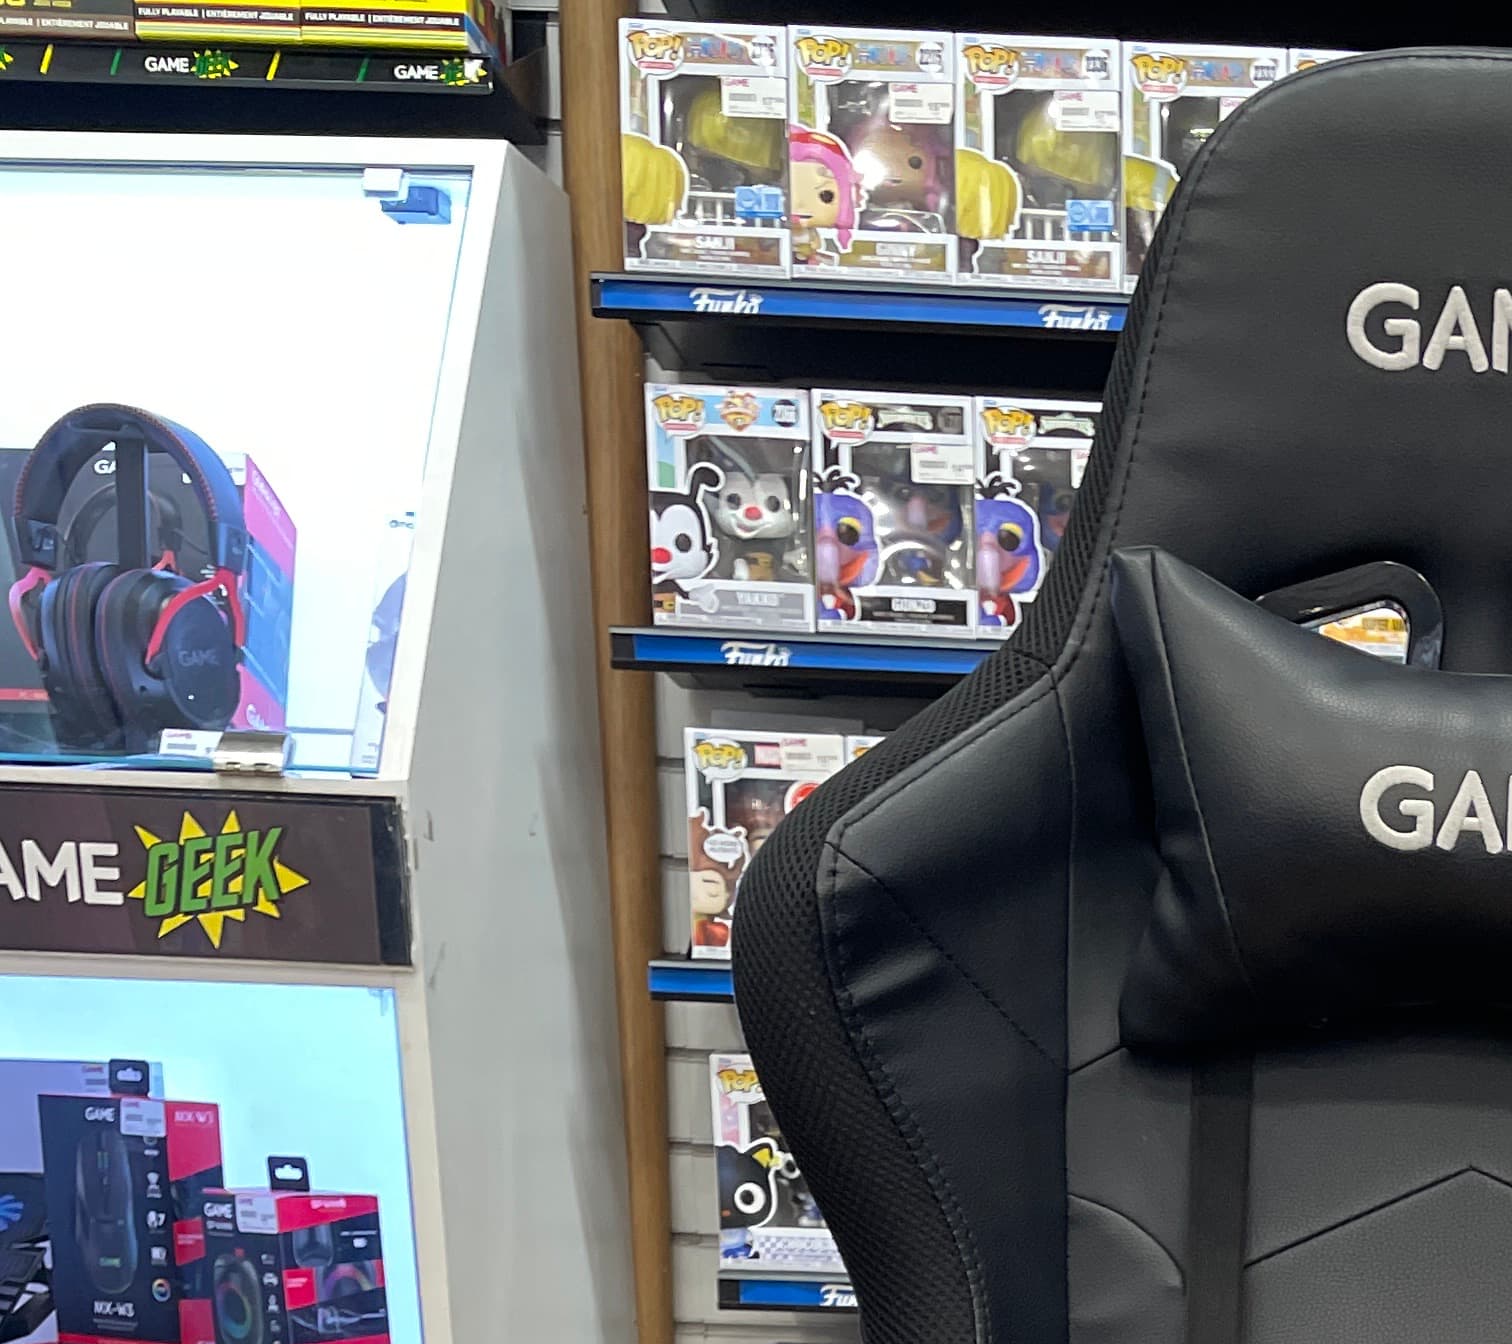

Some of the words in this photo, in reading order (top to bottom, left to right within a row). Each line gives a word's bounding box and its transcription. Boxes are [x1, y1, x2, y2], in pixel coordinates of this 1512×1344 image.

[627, 31, 682, 61] POP!
[796, 38, 851, 67] POP!
[963, 44, 1018, 74] POP!
[144, 56, 190, 73] GAME
[393, 64, 439, 80] GAME
[690, 287, 764, 315] Funko
[1038, 304, 1112, 332] Funko
[720, 640, 792, 667] Funko
[144, 826, 283, 918] GEEK
[84, 1106, 115, 1122] GAME
